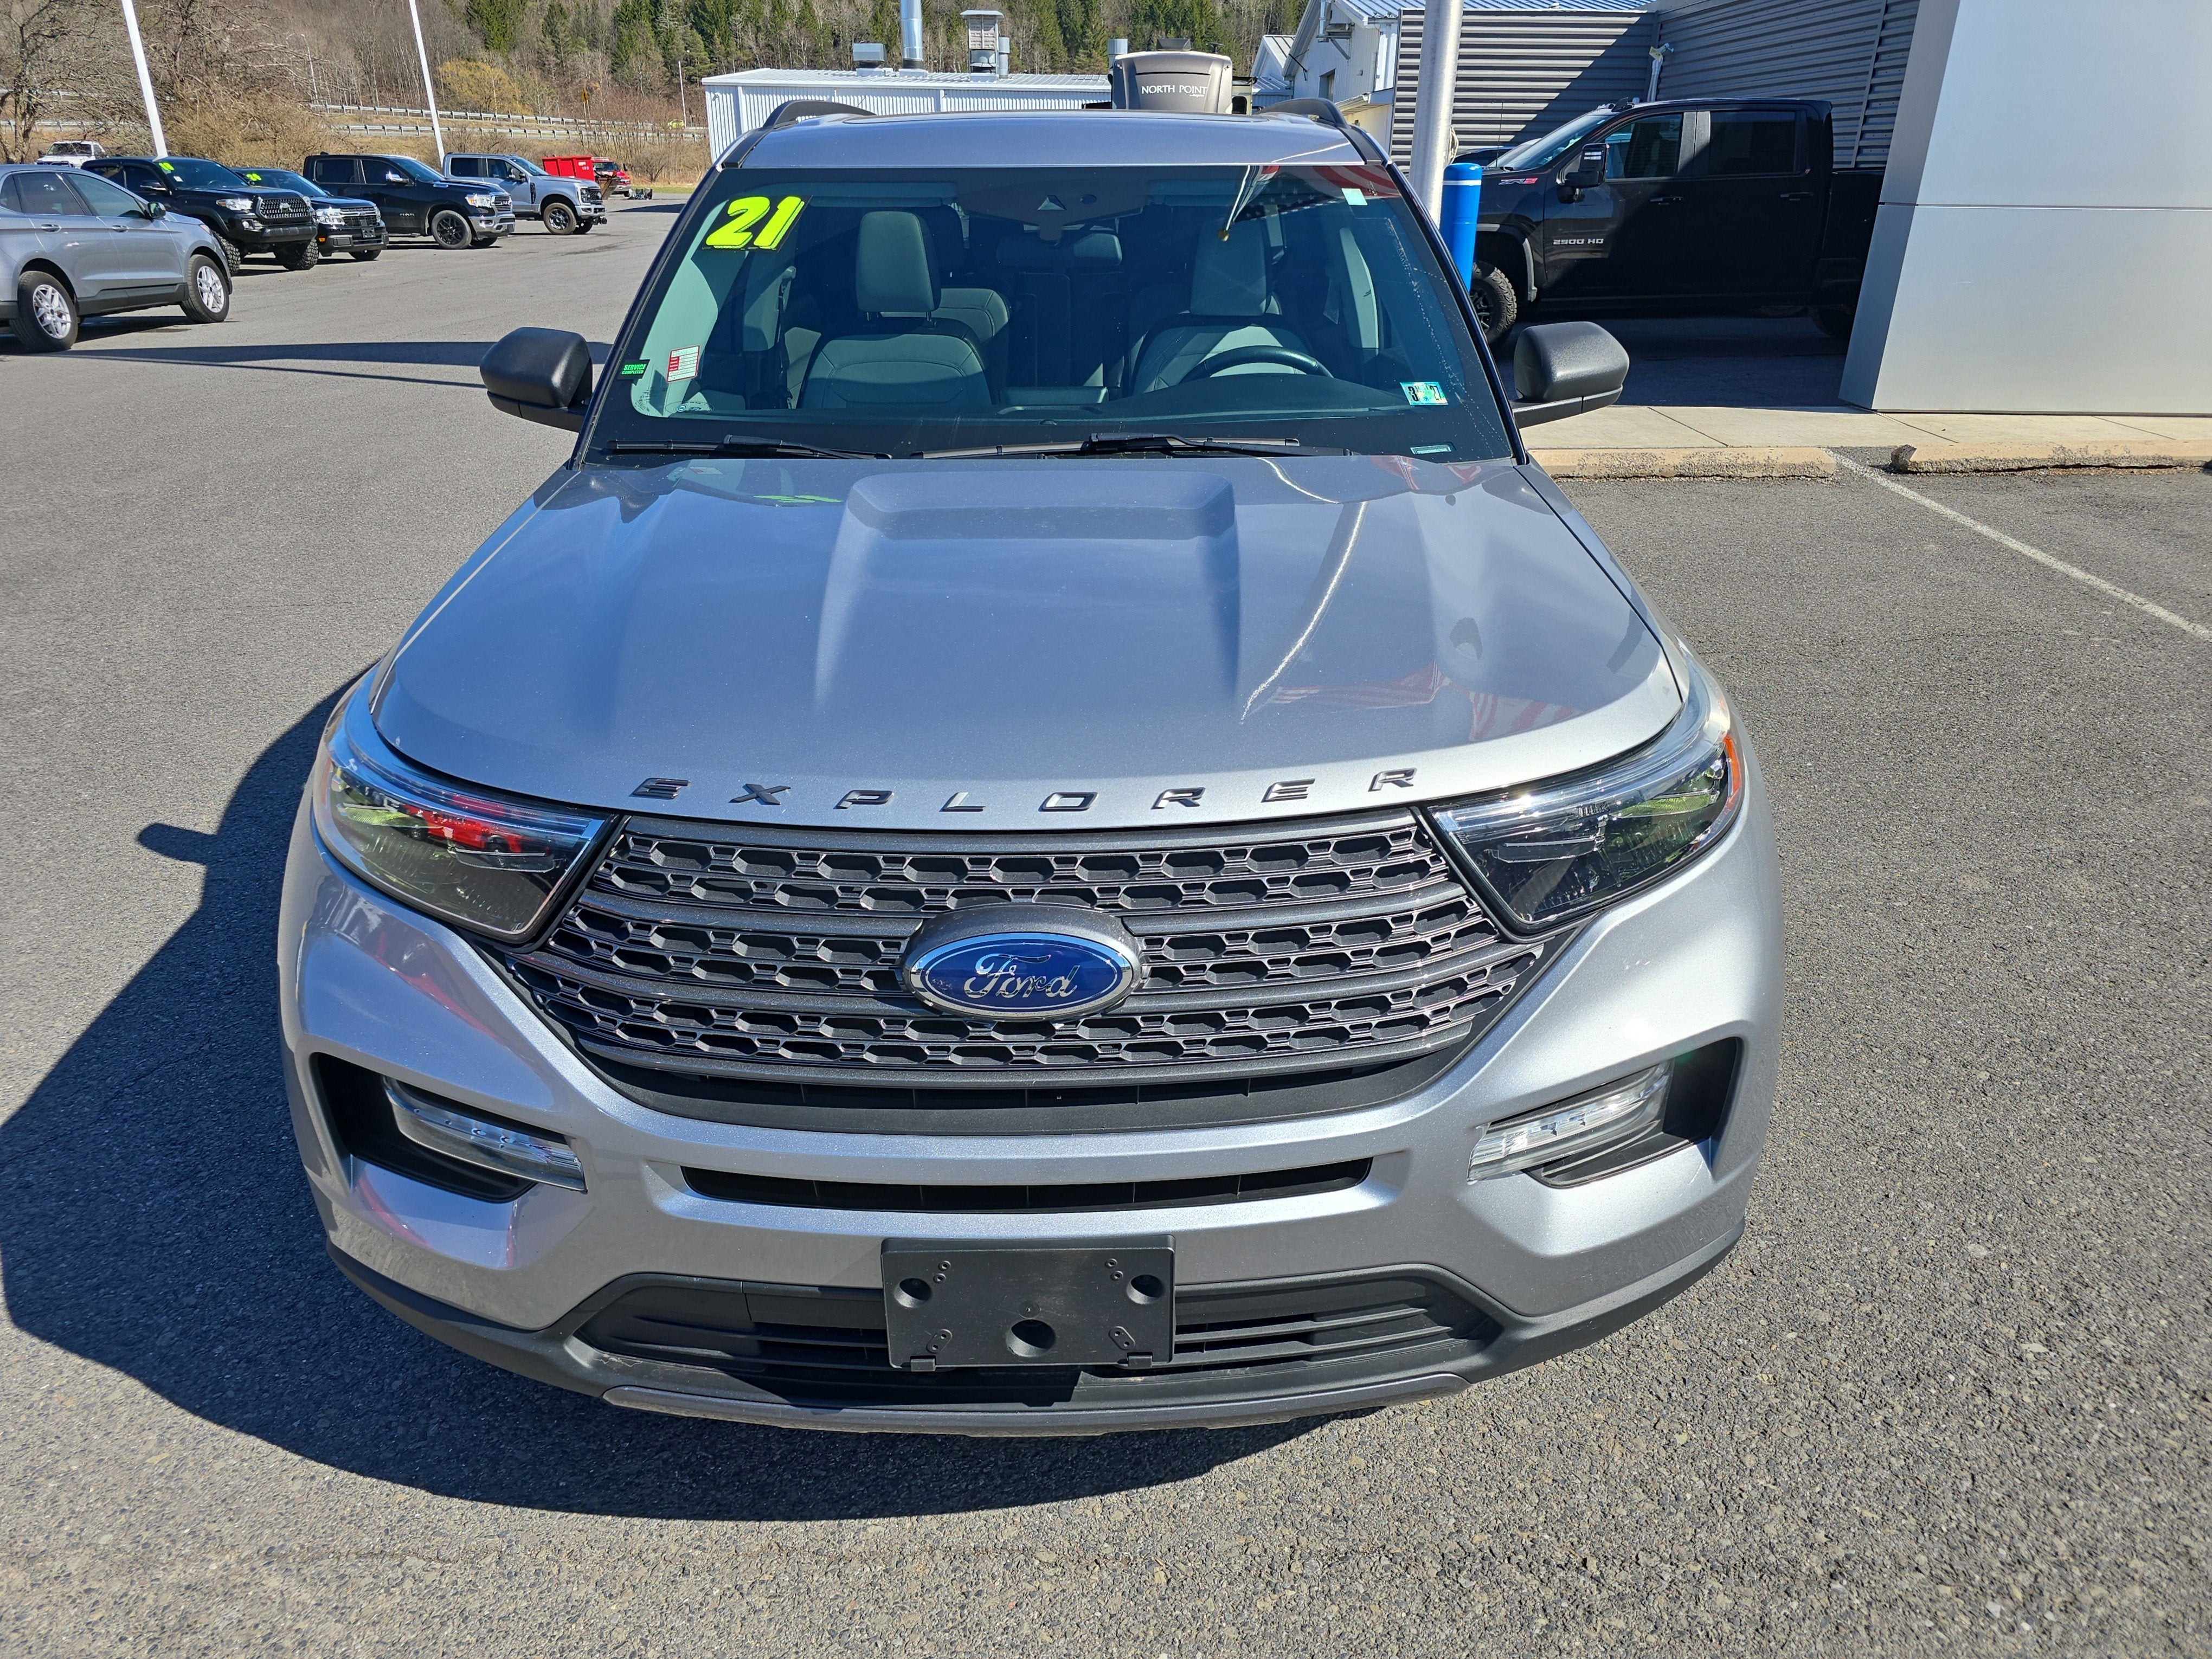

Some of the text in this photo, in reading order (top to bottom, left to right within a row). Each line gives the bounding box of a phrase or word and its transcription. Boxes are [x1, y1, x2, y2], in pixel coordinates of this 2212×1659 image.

[1141, 85, 1207, 94] NORTH POINT
[706, 196, 805, 249] 21
[1408, 386, 1419, 401] 3
[630, 767, 1418, 813] EXPLORER
[964, 953, 1081, 999] Ford
